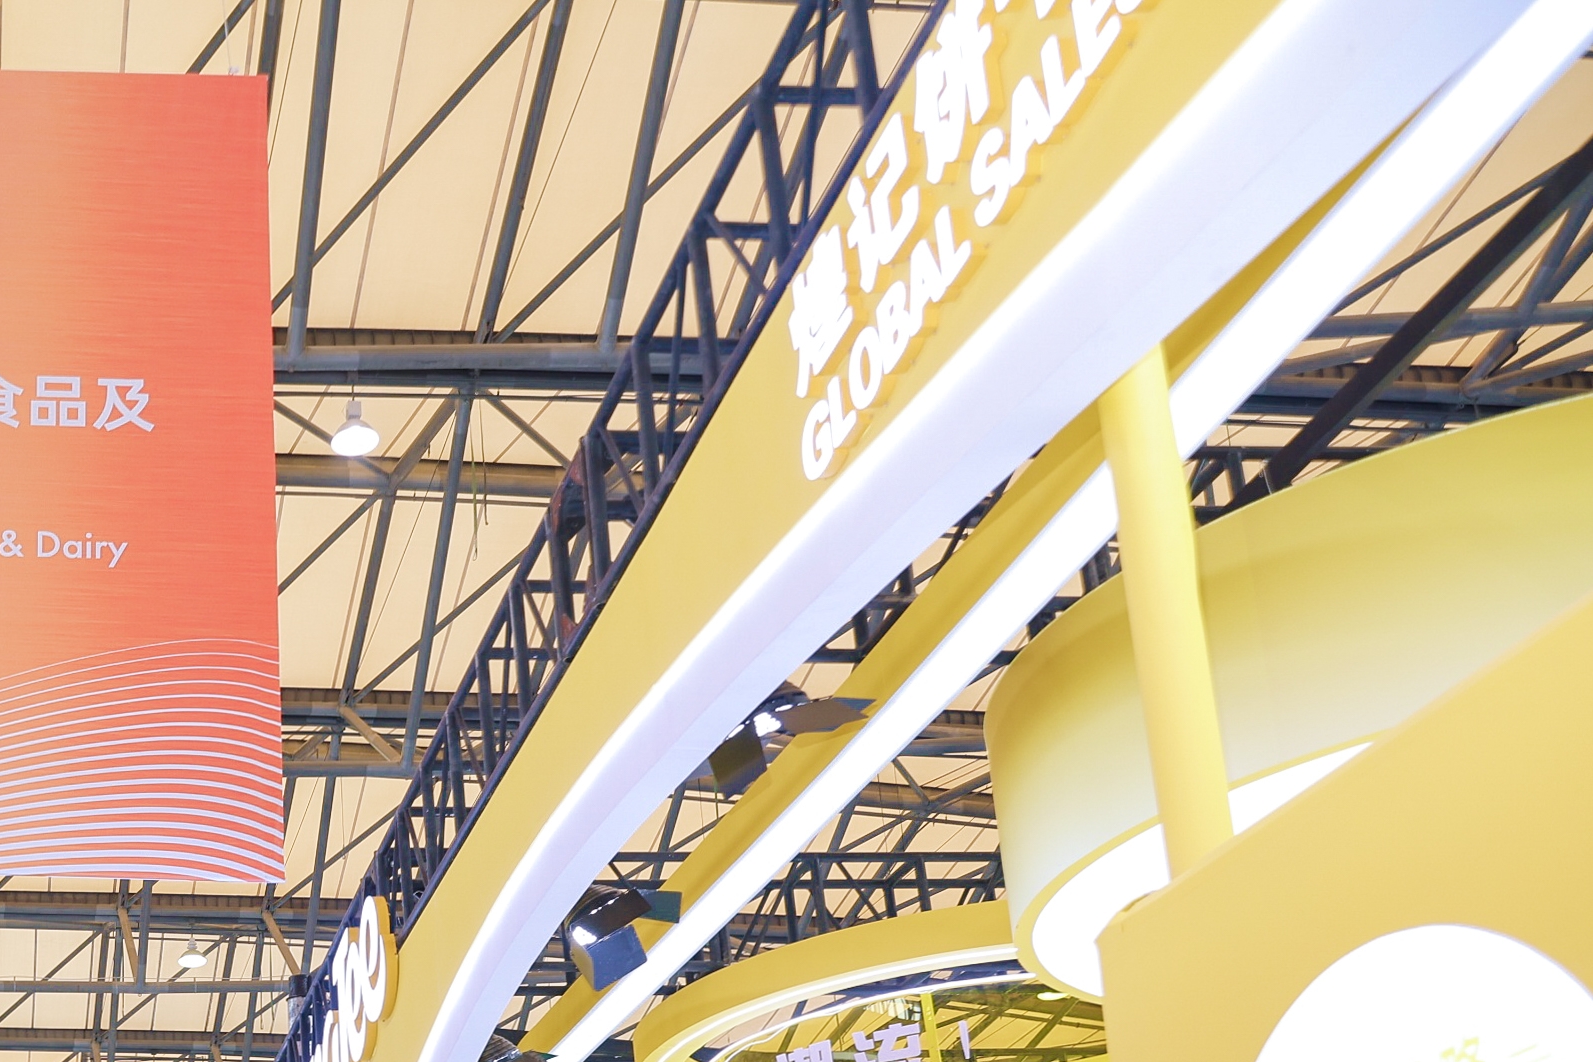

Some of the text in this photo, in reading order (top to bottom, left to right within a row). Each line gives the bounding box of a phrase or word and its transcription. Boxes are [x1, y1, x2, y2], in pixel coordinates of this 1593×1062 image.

[802, 0, 1143, 480] GLOBAL SALE
[36, 531, 128, 568] Dairy
